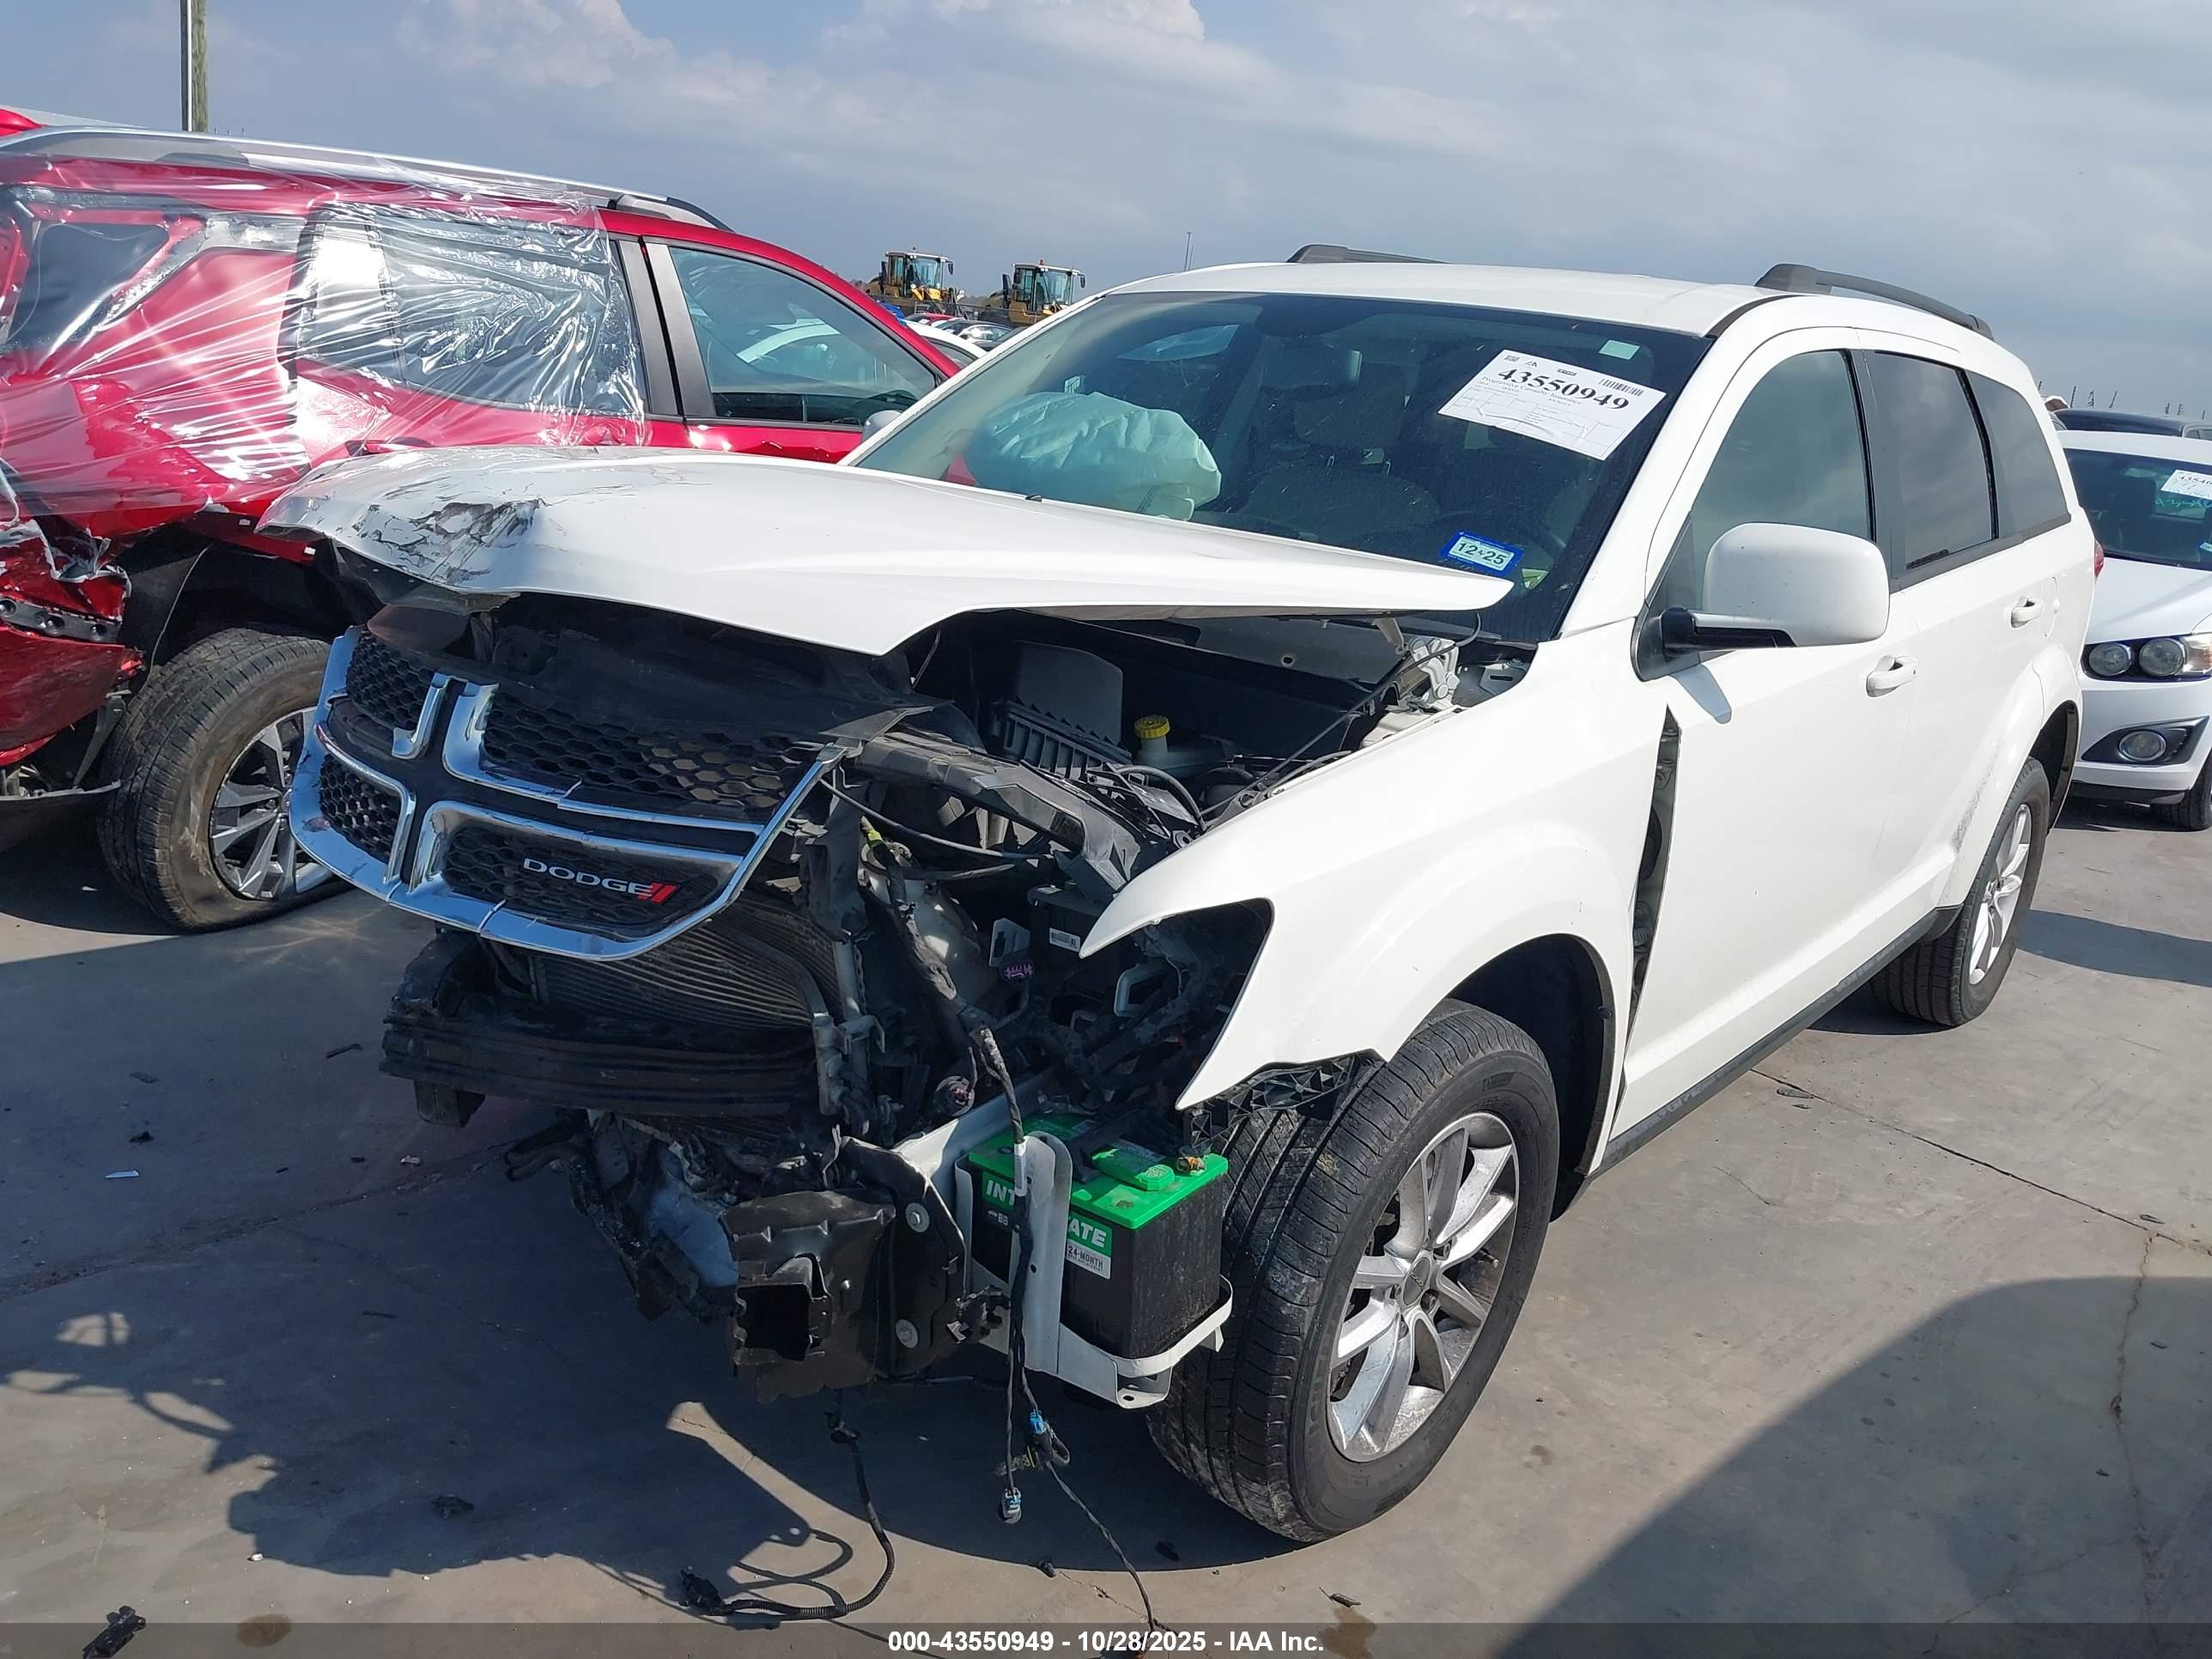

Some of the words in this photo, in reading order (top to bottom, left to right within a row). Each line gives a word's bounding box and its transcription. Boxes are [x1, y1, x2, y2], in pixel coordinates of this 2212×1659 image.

[1498, 368, 1630, 410] 43550949
[523, 858, 653, 897] DODGE
[1068, 1245, 1103, 1268] 24-MONTH
